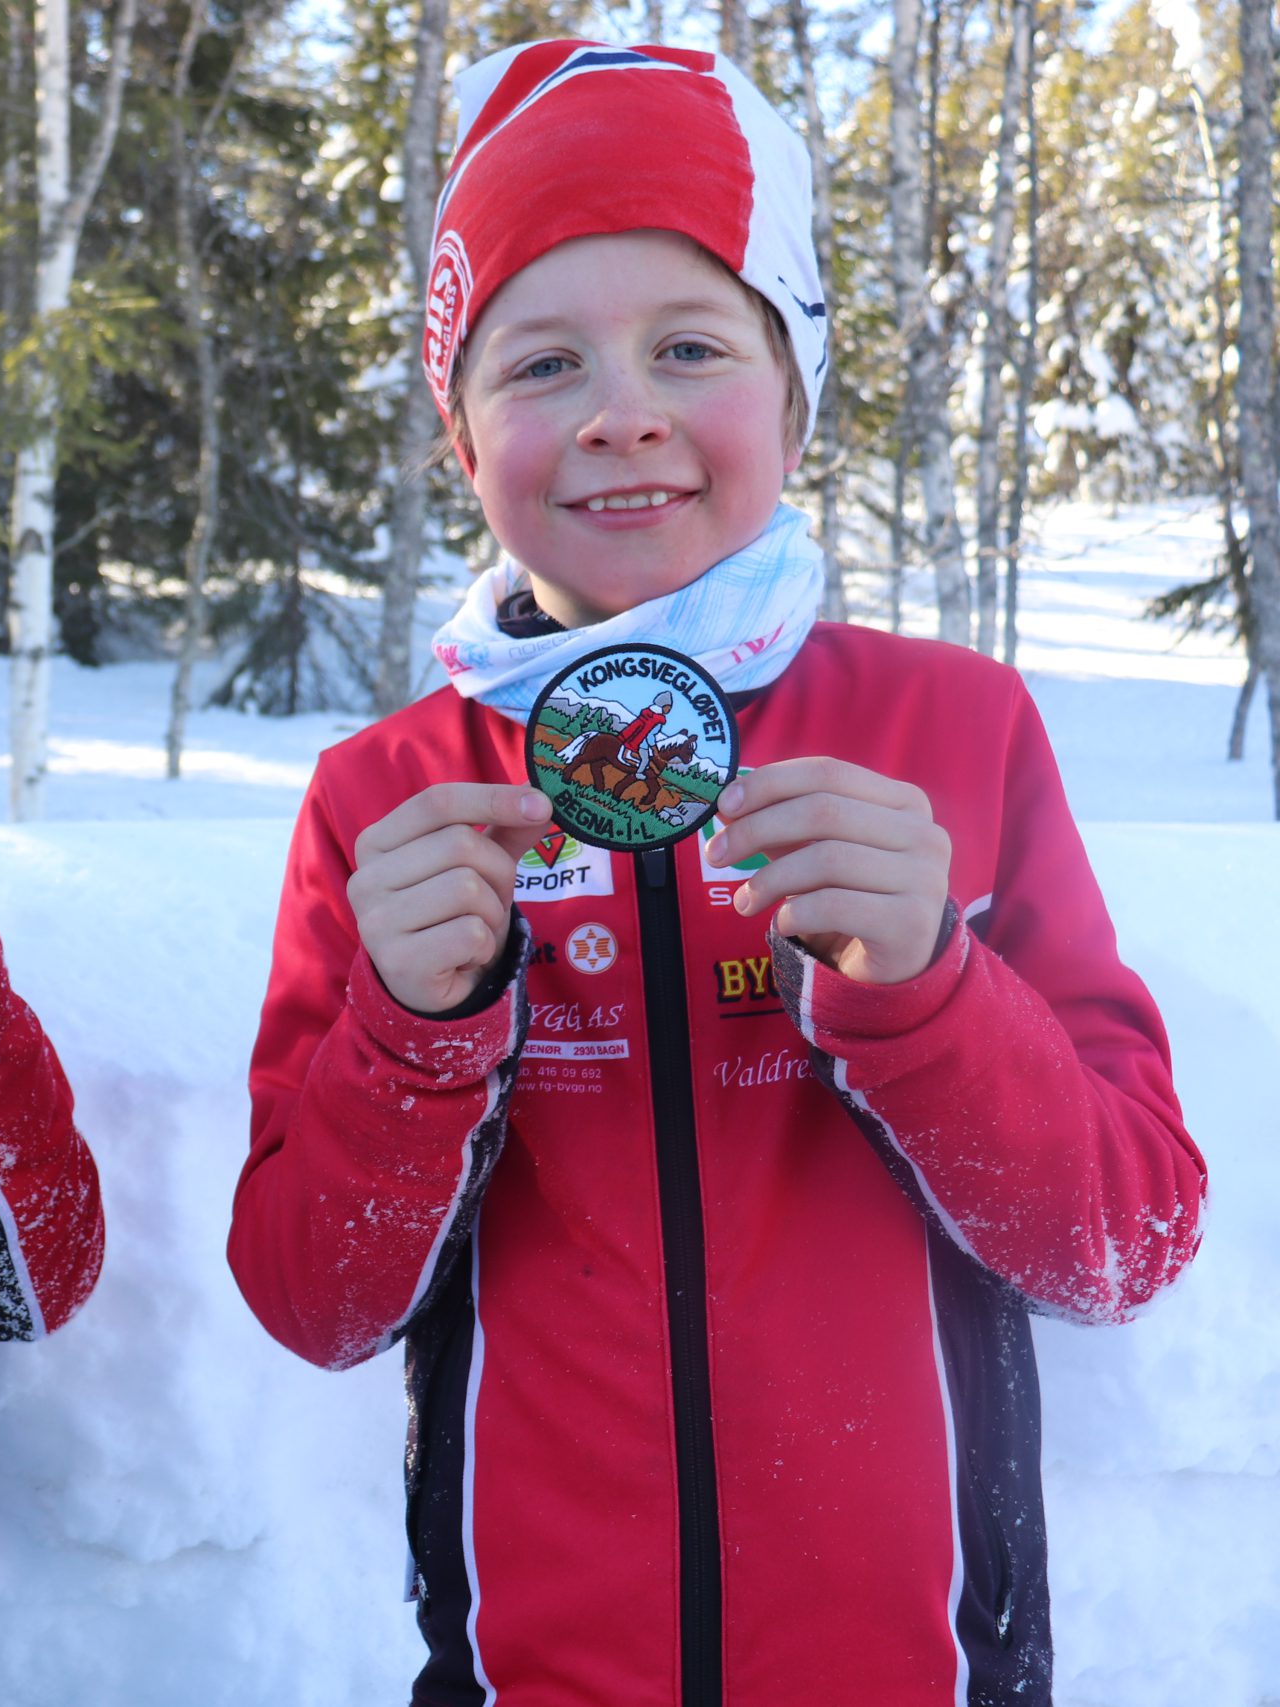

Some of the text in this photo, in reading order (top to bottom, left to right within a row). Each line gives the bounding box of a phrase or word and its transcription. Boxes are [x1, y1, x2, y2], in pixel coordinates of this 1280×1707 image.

[576, 657, 726, 744] KONGSVEGLØPET
[716, 957, 778, 1001] BY
[528, 1003, 625, 1032] YGG AS
[522, 1044, 562, 1055] RENØR
[597, 1044, 625, 1055] BAGN
[537, 1066, 557, 1077] 416
[561, 1067, 577, 1077] 09
[581, 1068, 602, 1079] 692
